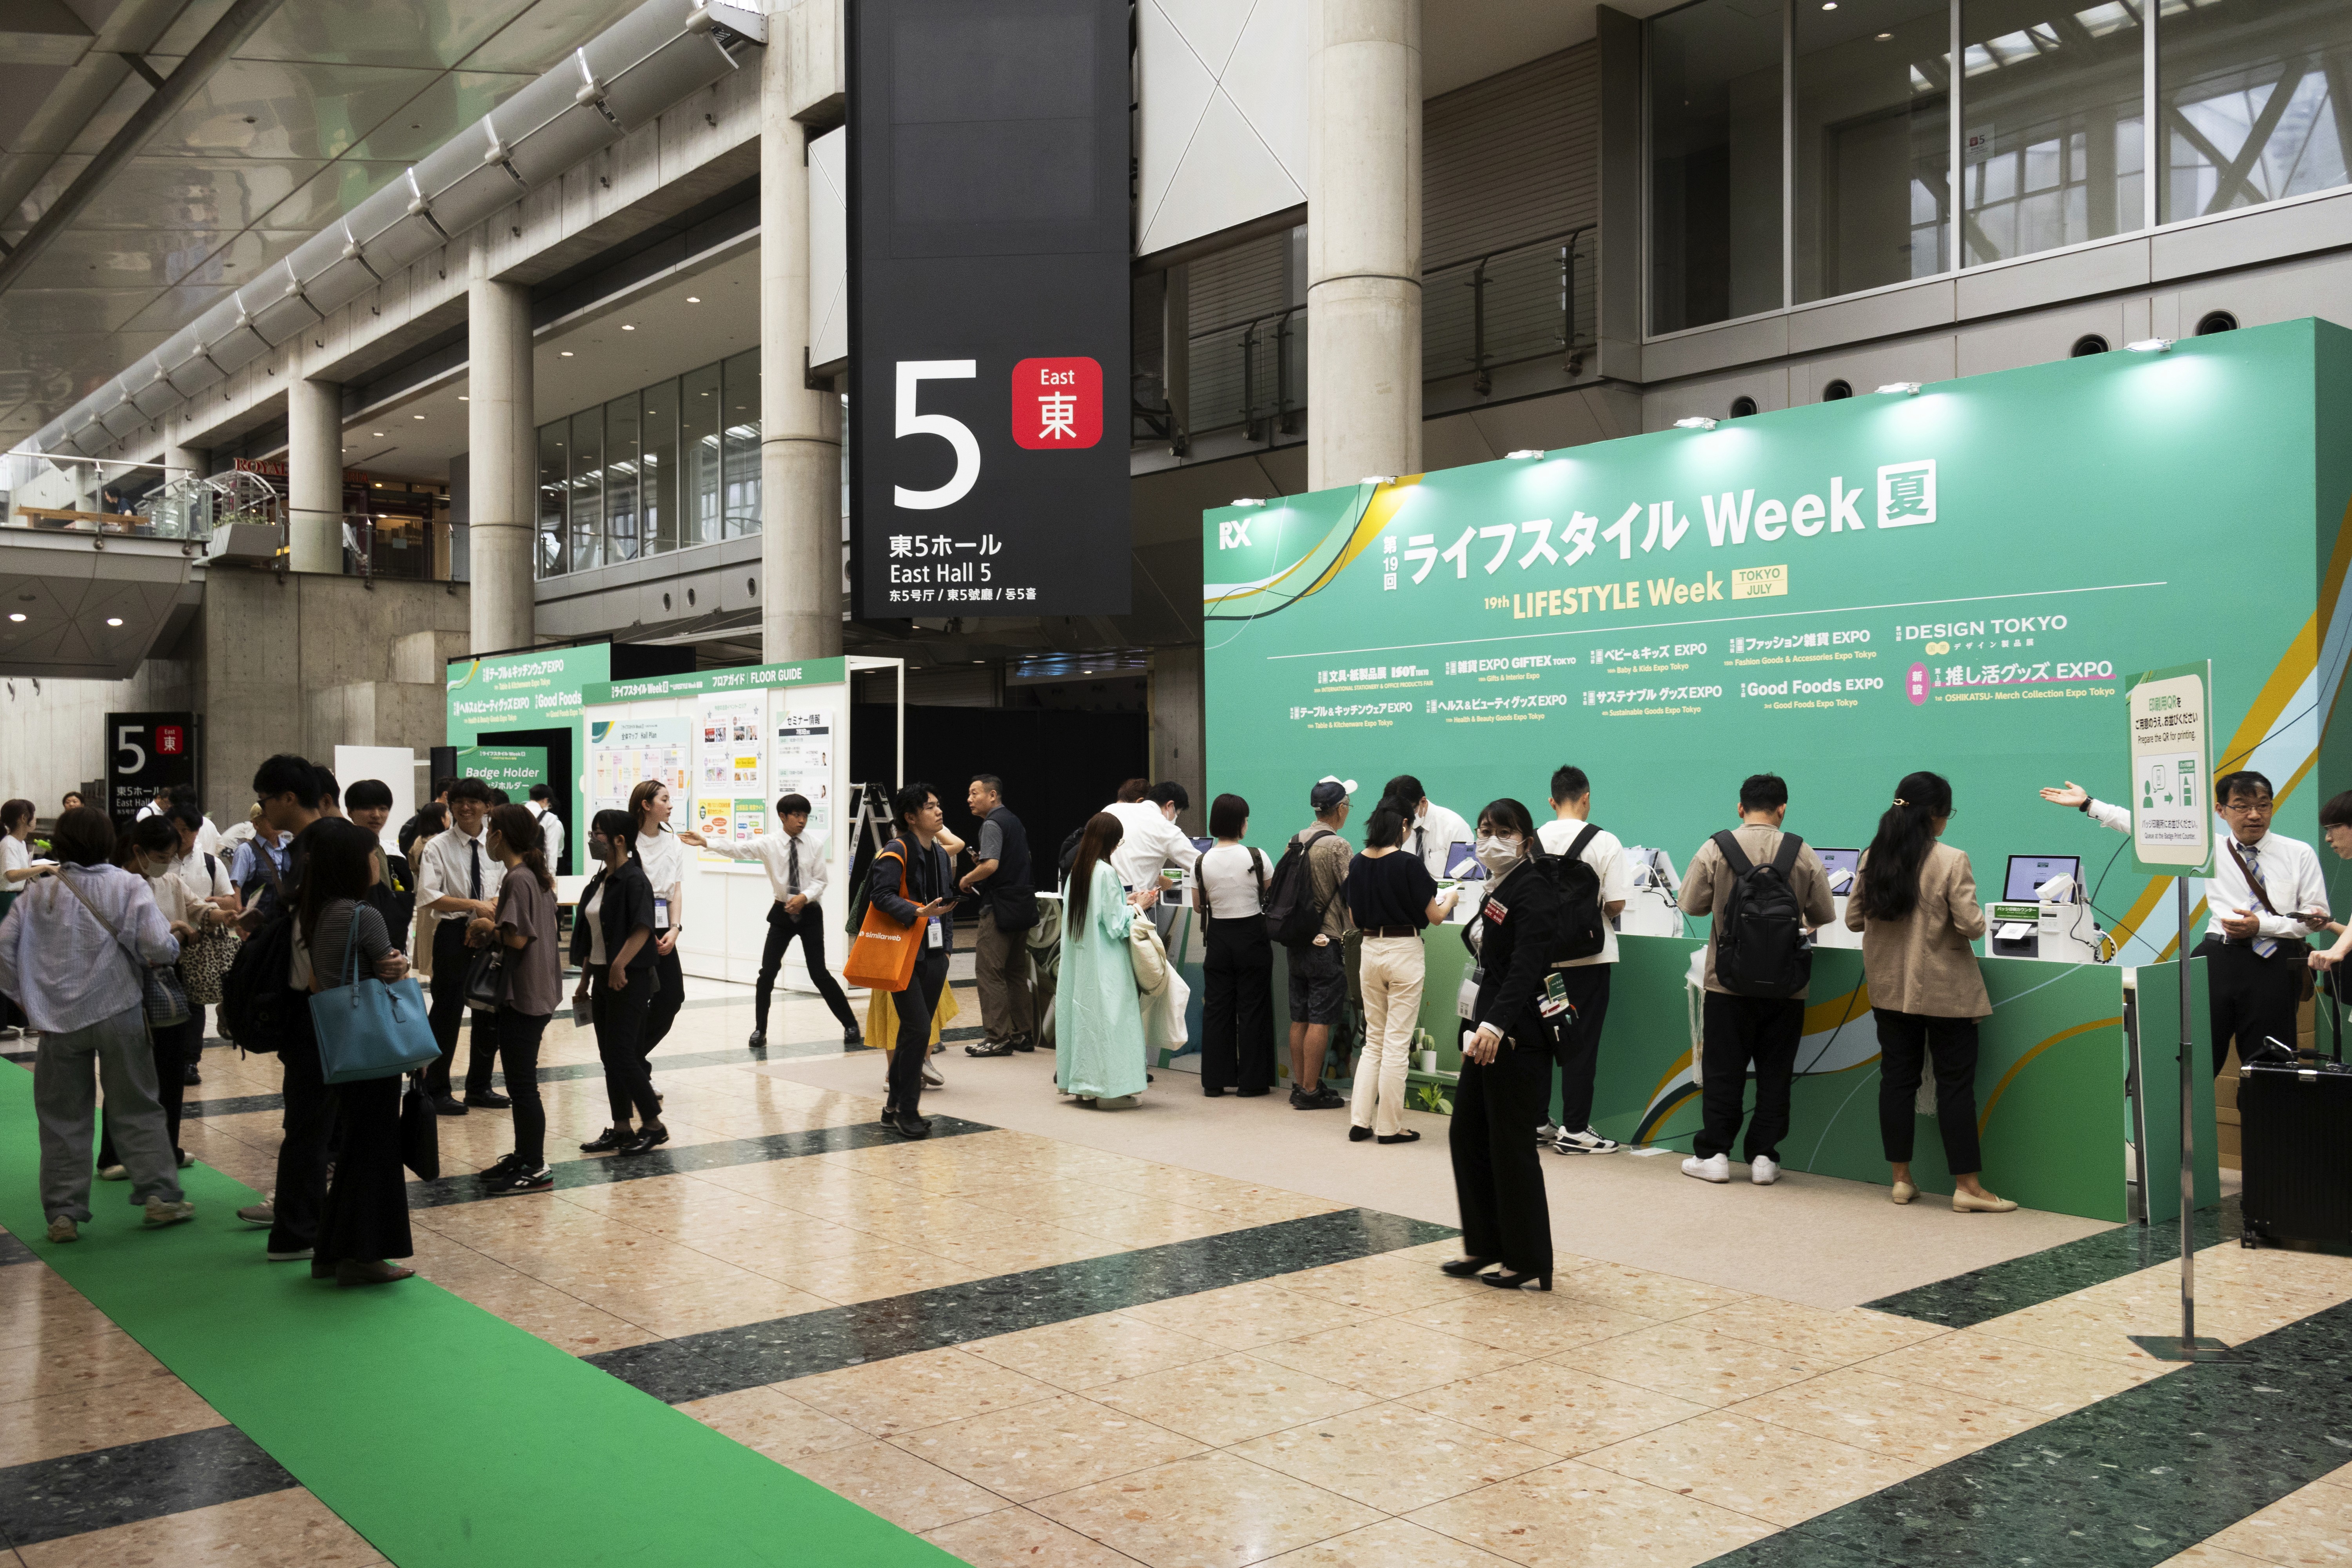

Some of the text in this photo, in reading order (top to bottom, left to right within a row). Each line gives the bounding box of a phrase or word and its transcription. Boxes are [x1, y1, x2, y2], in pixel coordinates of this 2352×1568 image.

[1979, 135, 1984, 144] 5
[1041, 369, 1075, 385] East
[1038, 392, 1077, 439] 東
[894, 359, 981, 510] 5
[234, 457, 289, 476] ROYAL
[1219, 518, 1252, 550] RX
[1404, 468, 1929, 585] ライフスタイル Week 夏
[889, 534, 1002, 558] 東5ホール
[1383, 535, 1398, 591] 第19回
[891, 562, 991, 583] East Hall 5
[1739, 568, 1780, 582] TOKYO
[889, 589, 935, 602] 东5号厅
[947, 588, 993, 601] 東5號廳
[1005, 587, 1036, 600] 동5홀
[1484, 571, 1724, 619] 19th LIFESTYLE Week
[1747, 583, 1772, 596] JULY
[1905, 615, 2067, 640] DESIGN TOKYO
[1746, 632, 1829, 650] ファッション雑貨
[1833, 630, 1870, 644] EXPO
[1954, 639, 2034, 650] デザイン製品展
[1604, 645, 1670, 661] ベビー&キッズ
[1675, 643, 1707, 656] EXPO
[1793, 654, 1833, 662] Accessories
[1835, 653, 1853, 661] Expo
[1854, 651, 1877, 659] Tokyo
[547, 659, 564, 673] EXPO
[1392, 665, 1416, 678] ISOT
[1458, 660, 1477, 673] 雑貨
[1479, 658, 1509, 671] EXPO
[1512, 655, 1552, 668] GIFTEX
[712, 673, 745, 687] フロアガイド
[751, 670, 776, 684] FLOOR
[778, 668, 802, 681] GUIDE
[1945, 661, 2112, 686] 推し活グッズ EXPO
[615, 684, 647, 697] ライフスタイル
[648, 682, 662, 694] Week
[1748, 677, 1884, 696] Good Foods EXPO
[1912, 671, 1923, 695] 新設
[538, 693, 557, 708] Good
[559, 690, 582, 705] Foods
[1539, 694, 1567, 706] EXPO
[1689, 686, 1722, 699] EXPO
[1945, 692, 1993, 702] OSHIKATSU-
[1995, 691, 2020, 700] Merch
[2022, 689, 2064, 699] Collection
[2066, 688, 2087, 699] Expo
[2089, 687, 2115, 697] Tokyo
[514, 697, 529, 709] EXPO
[1388, 702, 1412, 713] EXPO
[1816, 700, 1834, 708] Expo
[1836, 699, 1858, 708] Tokyo
[2149, 695, 2181, 712] 印刷用QRを
[788, 714, 820, 725] セミナー情報
[163, 736, 176, 751] 東
[2138, 735, 2153, 745] Prepare
[2163, 733, 2169, 741] QR
[2178, 730, 2196, 742] printing.
[118, 726, 145, 774] 5
[466, 767, 539, 780] Badge Holder
[117, 799, 132, 807] East
[866, 931, 901, 941] similarweb
